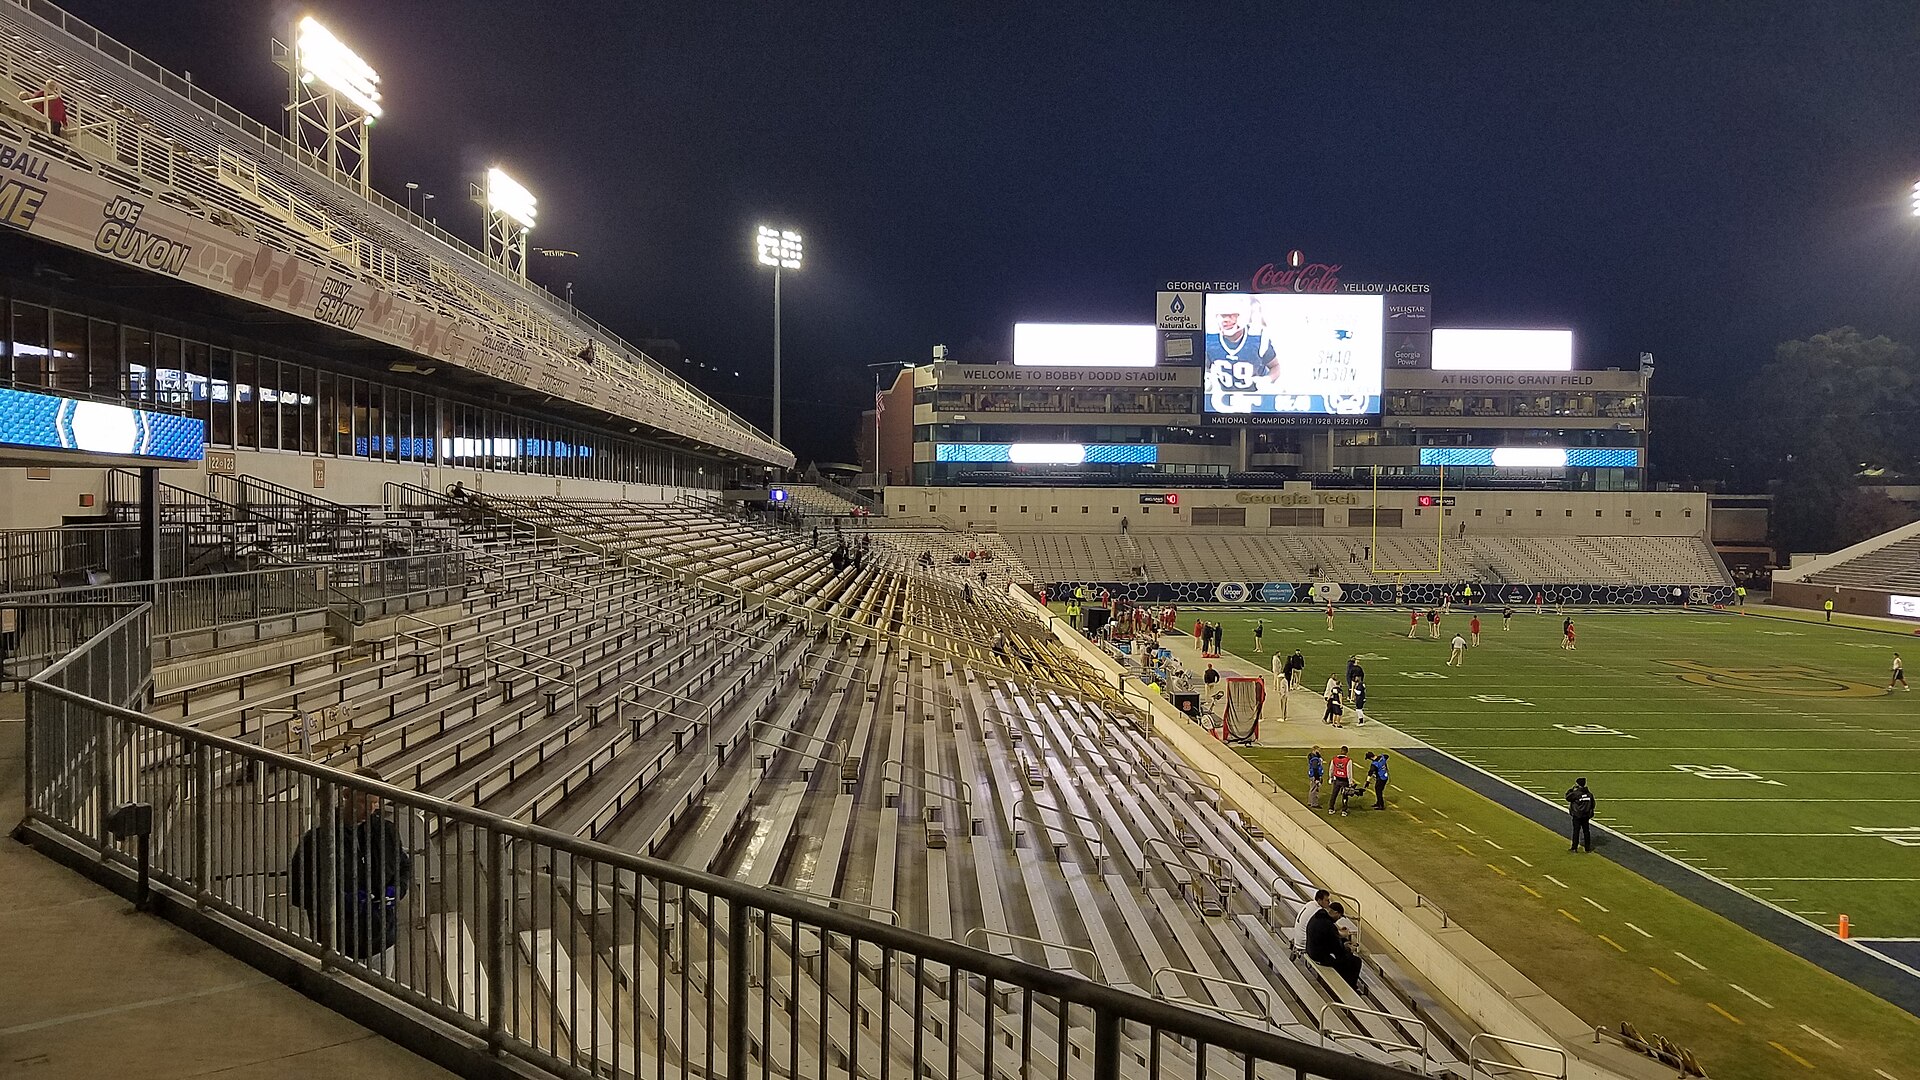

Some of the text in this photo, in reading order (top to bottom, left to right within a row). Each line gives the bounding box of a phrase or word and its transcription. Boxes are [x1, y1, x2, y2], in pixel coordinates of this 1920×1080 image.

[0, 144, 50, 183] BALL
[103, 195, 145, 225] JOE
[95, 219, 192, 276] GUYON
[1251, 263, 1343, 294] Coca-Cola
[320, 277, 352, 300] BILLY
[1166, 281, 1240, 291] GEORGIA TECH
[1343, 283, 1430, 293] YELLOW JACKETS
[314, 297, 364, 330] SHAW
[1164, 314, 1191, 323] Georgia
[481, 335, 529, 362] COLLEGE FOOTBALL
[1394, 350, 1421, 360] Georgia
[465, 346, 493, 374] HALL
[490, 355, 508, 379] OF
[504, 360, 532, 386] FAME
[1397, 358, 1418, 366] Power
[963, 370, 1177, 381] WELCOME TO BOBBY DODD STADIUM
[1211, 360, 1254, 389] 69
[1441, 375, 1593, 385] AT HISTORIC GRANT FIELD
[1211, 417, 1248, 425] NATIONAL
[1352, 418, 1369, 426] 1990
[208, 456, 235, 471] 122 123
[315, 470, 324, 481] 123
[1166, 494, 1176, 504] 40
[1236, 491, 1358, 507] Georgia Tech
[1419, 496, 1430, 506] 40
[1223, 585, 1242, 599] Kroger
